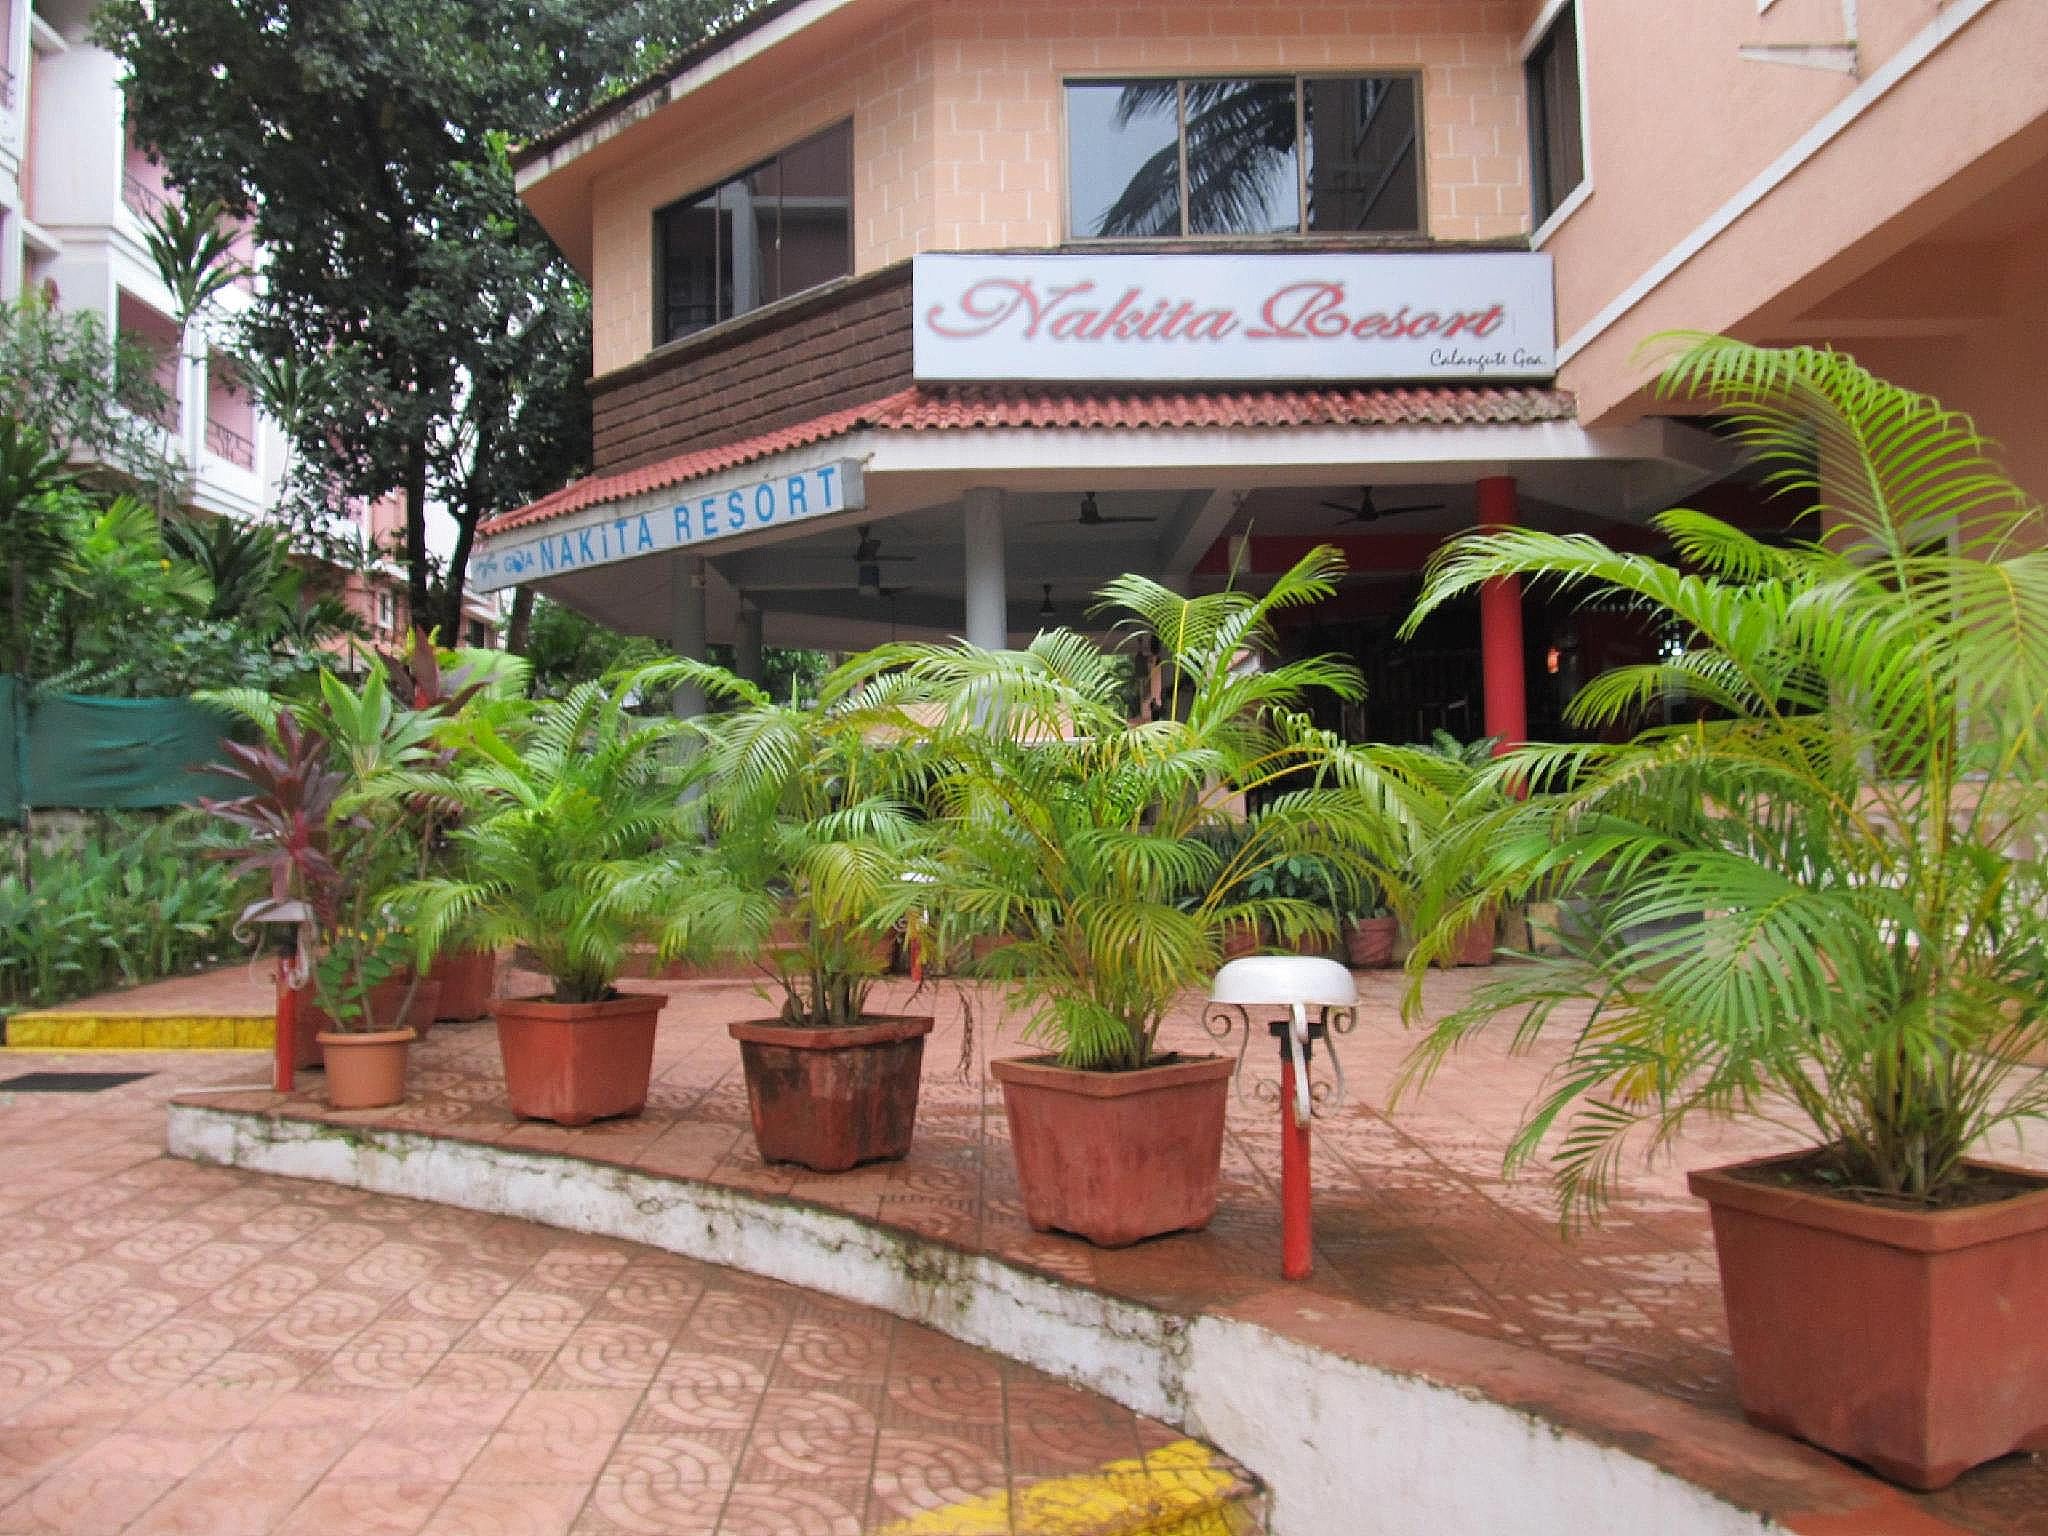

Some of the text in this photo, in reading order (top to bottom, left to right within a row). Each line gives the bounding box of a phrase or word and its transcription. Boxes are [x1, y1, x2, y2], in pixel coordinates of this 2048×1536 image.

[927, 277, 1504, 339] Nakita Resort
[1430, 348, 1506, 373] Calangute
[674, 467, 835, 546] RESORT
